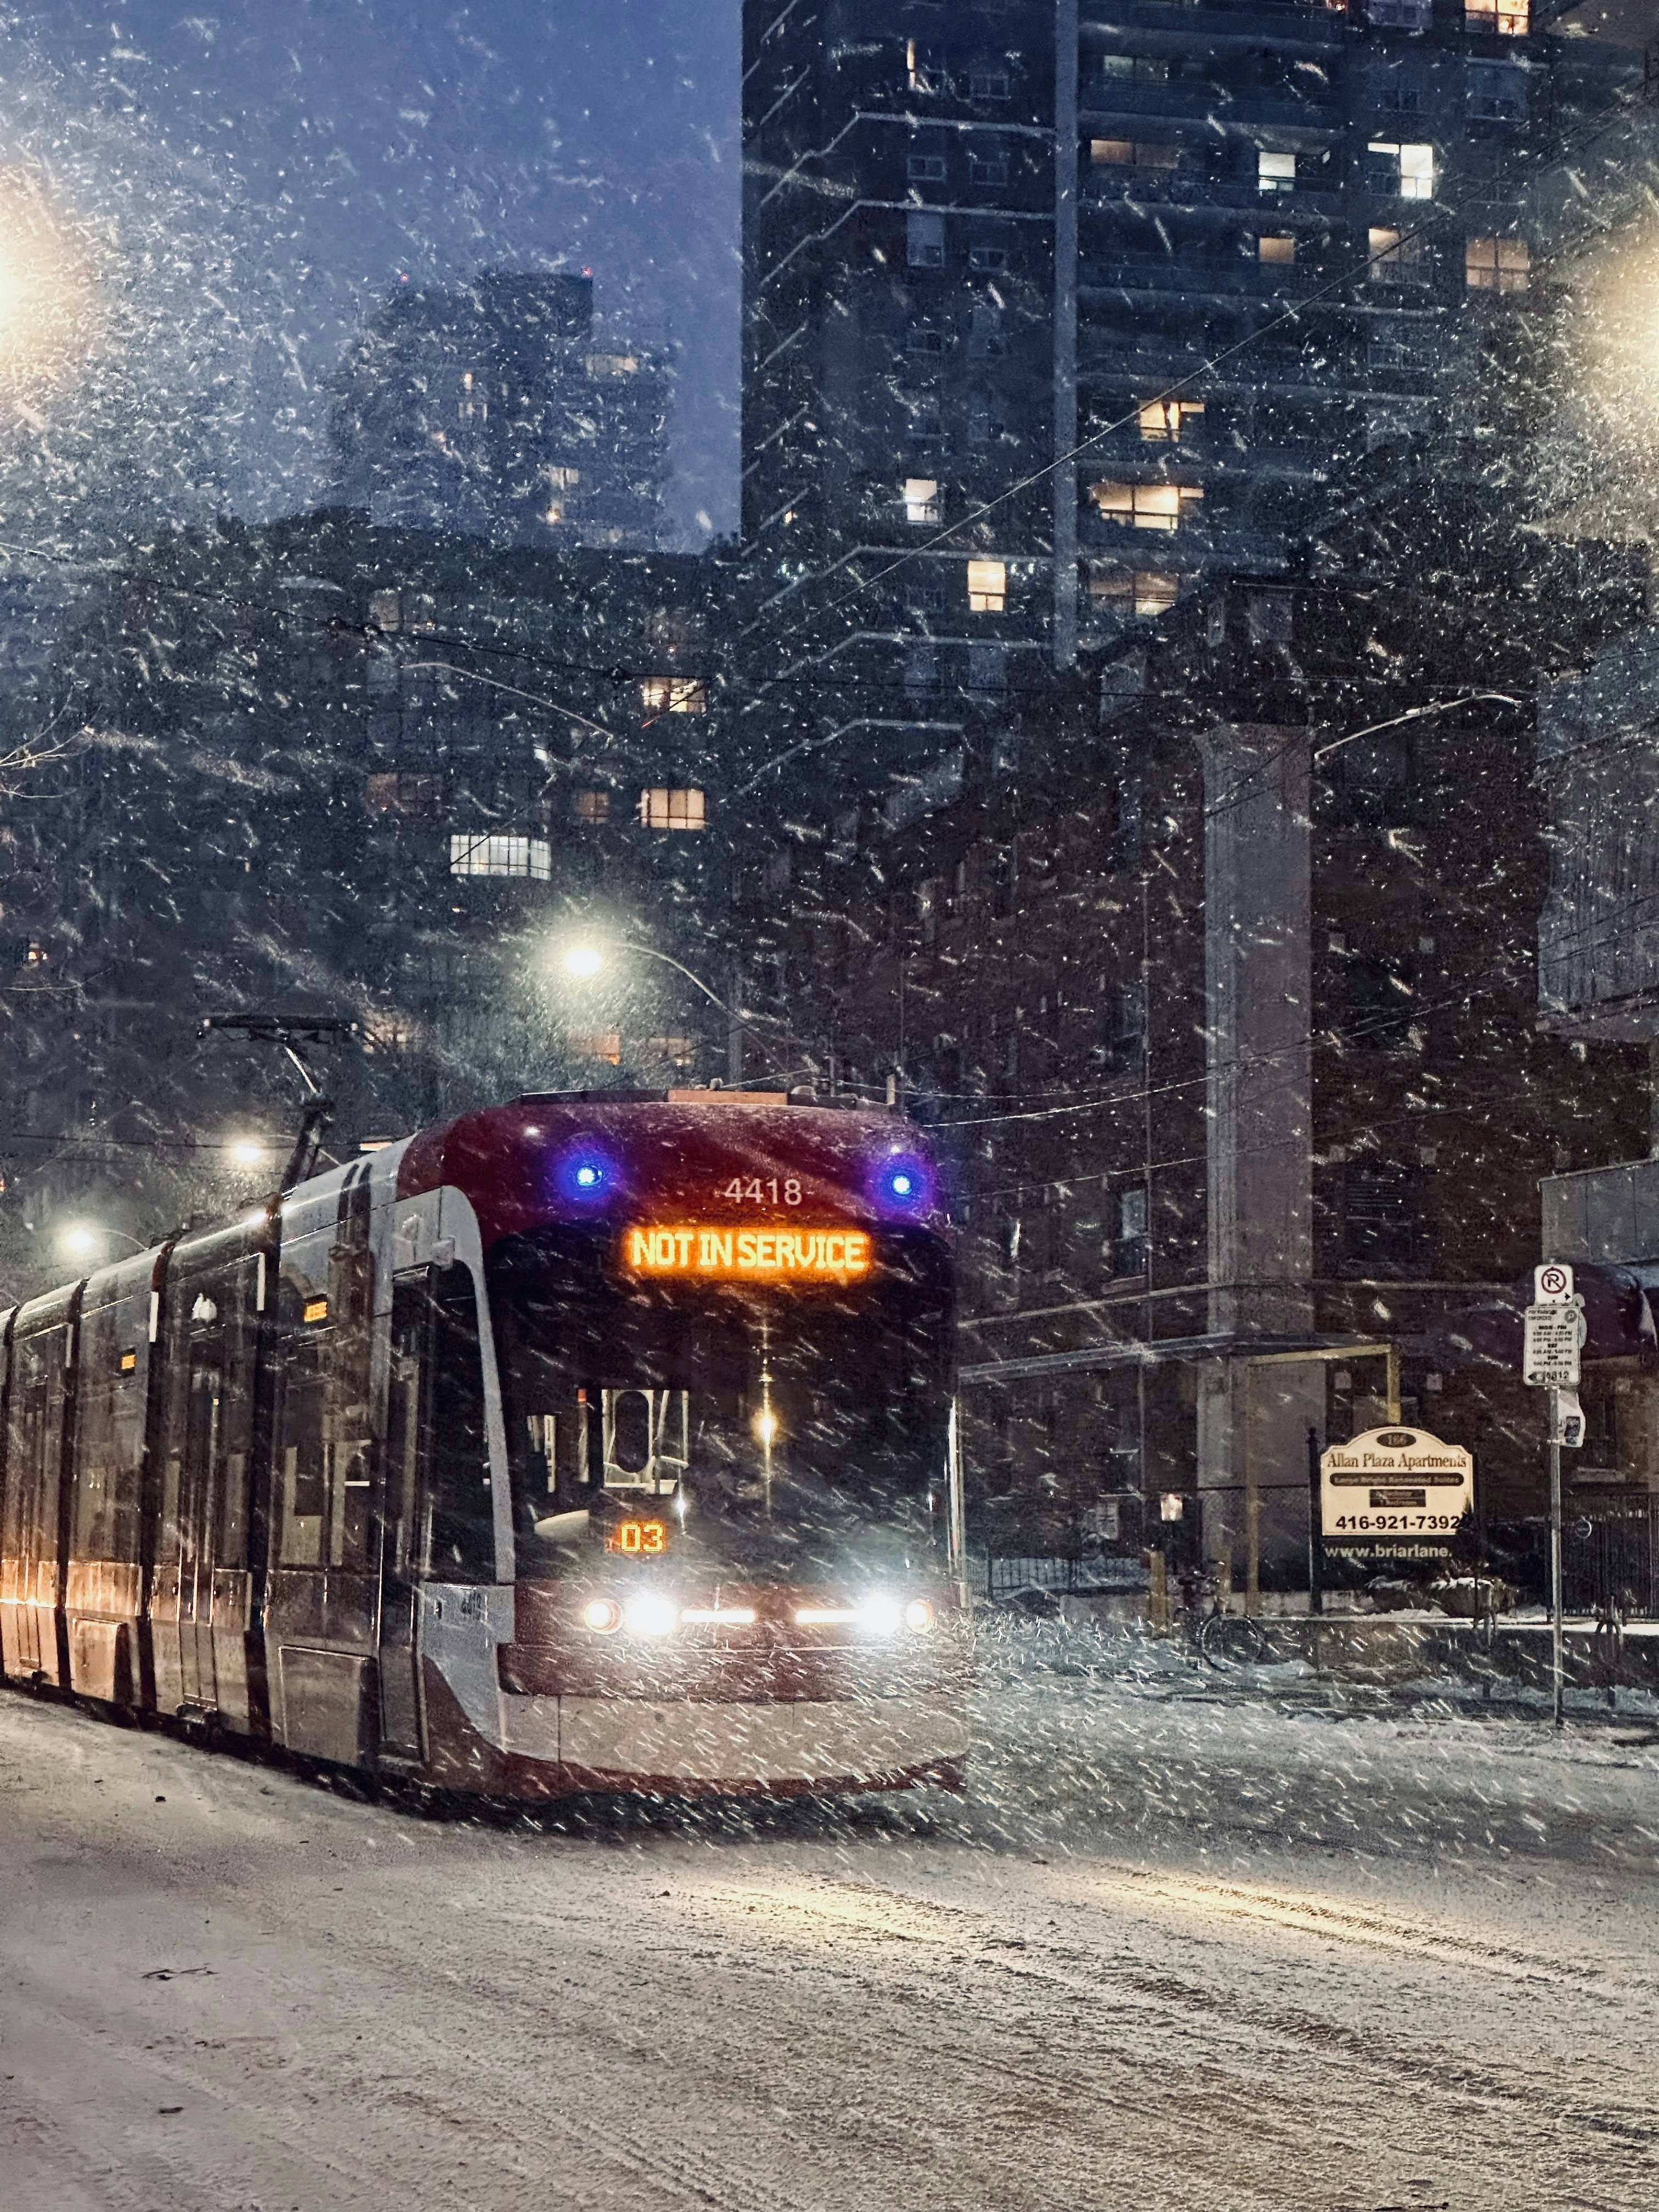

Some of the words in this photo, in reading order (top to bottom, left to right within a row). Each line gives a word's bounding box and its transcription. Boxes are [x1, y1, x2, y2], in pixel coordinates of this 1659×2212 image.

[724, 1177, 802, 1205] 4418
[632, 1231, 694, 1267] NOT
[699, 1233, 733, 1266] IN
[737, 1234, 865, 1268] SERVICE
[1328, 1453, 1358, 1468] Allan
[1363, 1453, 1395, 1468] Plaza
[1398, 1453, 1466, 1470] Apartments
[1336, 1516, 1461, 1530] 416-921-7392
[620, 1523, 663, 1553] 03
